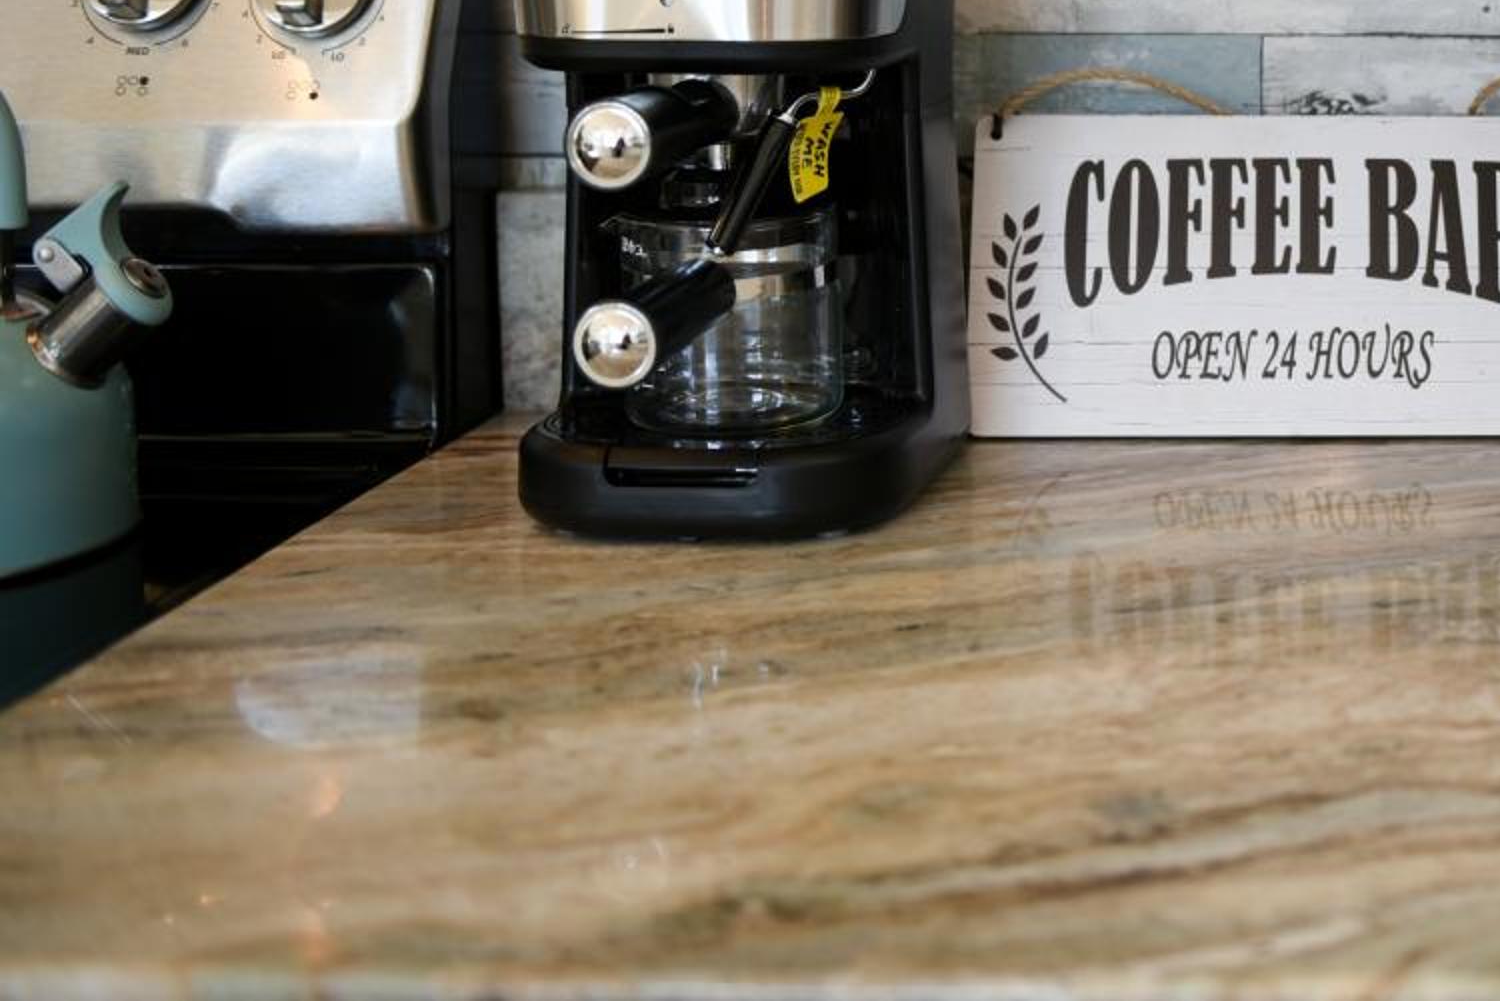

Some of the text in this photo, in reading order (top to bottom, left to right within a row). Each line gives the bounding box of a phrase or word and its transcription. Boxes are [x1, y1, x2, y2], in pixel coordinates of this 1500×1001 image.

[803, 137, 815, 168] ME
[813, 121, 833, 178] WASH
[1064, 158, 1338, 308] COFFEE
[1151, 322, 1435, 390] OPEN 24 HOURS
